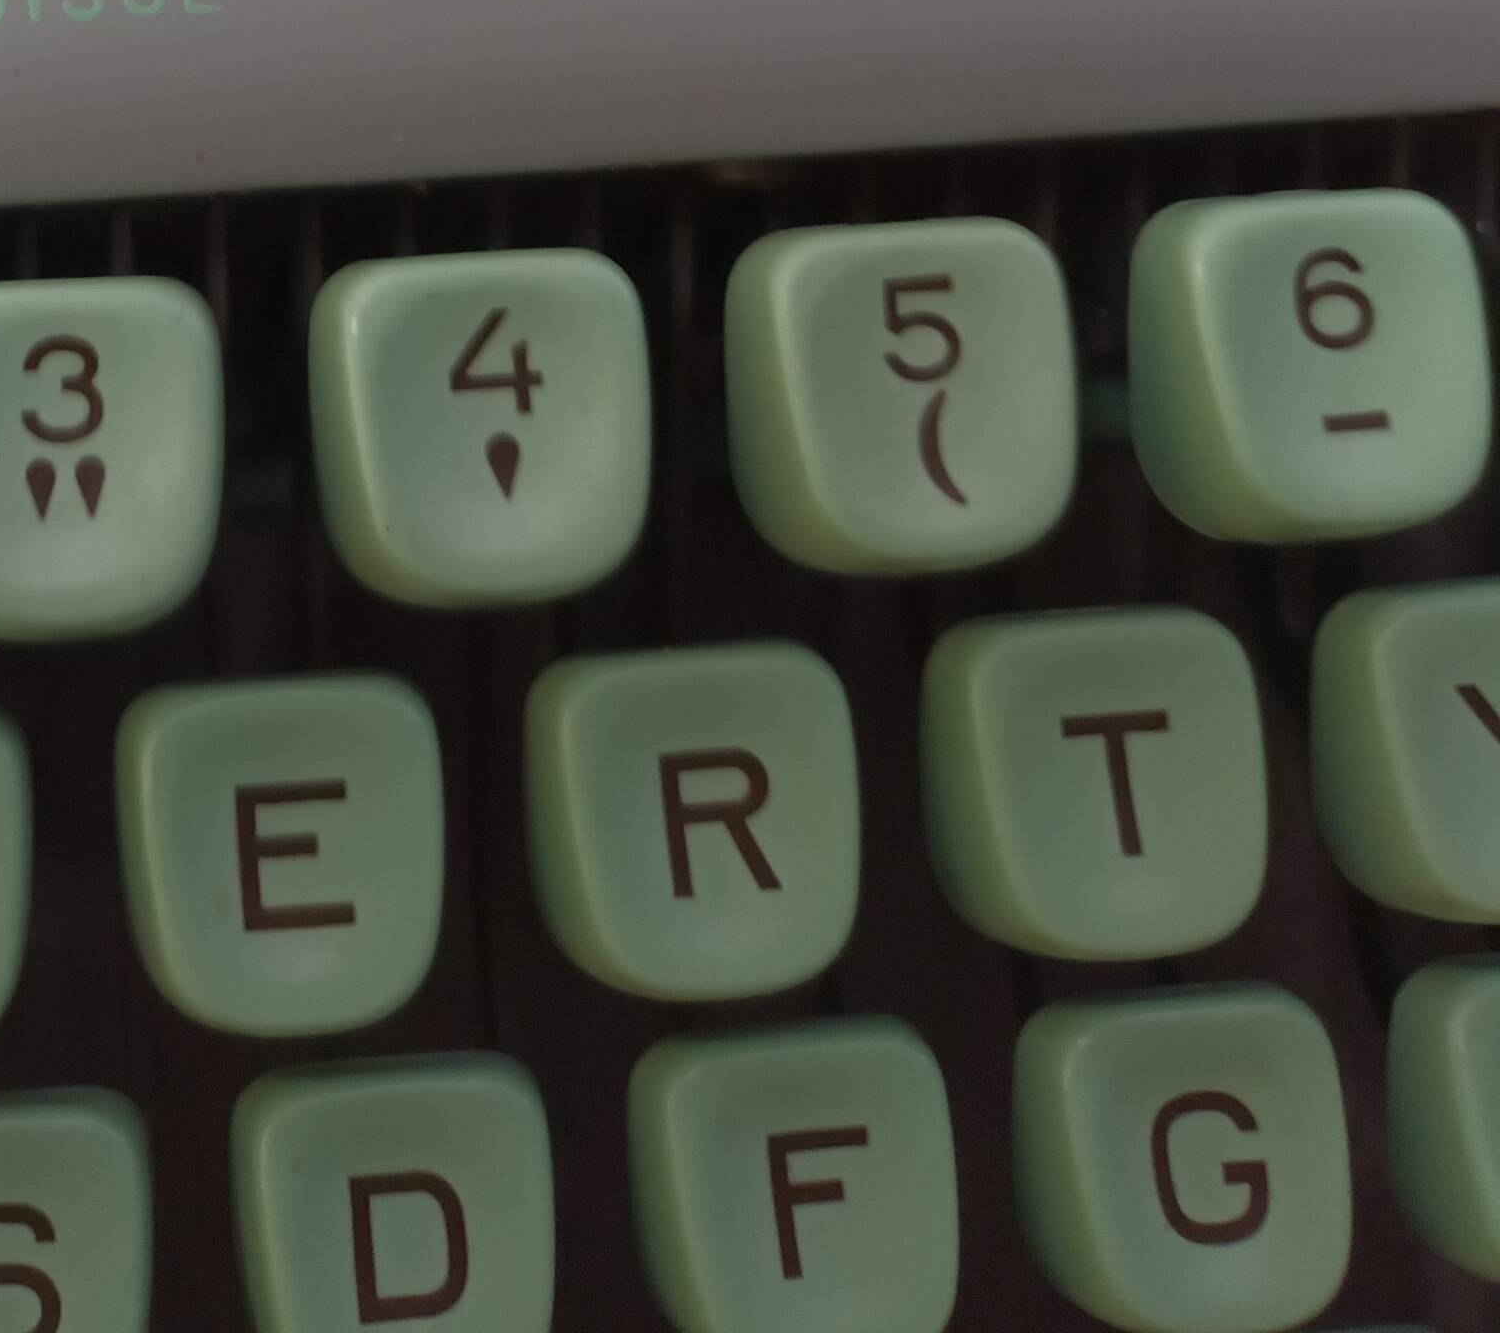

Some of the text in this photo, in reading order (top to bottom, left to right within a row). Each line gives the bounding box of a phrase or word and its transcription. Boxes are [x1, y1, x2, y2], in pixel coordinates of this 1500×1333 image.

[448, 306, 544, 415] 4
[881, 273, 962, 383] 5
[1293, 247, 1376, 351] 6
[21, 334, 103, 444] 3
[233, 777, 358, 933] E
[658, 746, 783, 899] R
[1060, 709, 1170, 858] T
[765, 1125, 871, 1280] F
[1149, 1088, 1271, 1245] G
[347, 1168, 470, 1325] D
